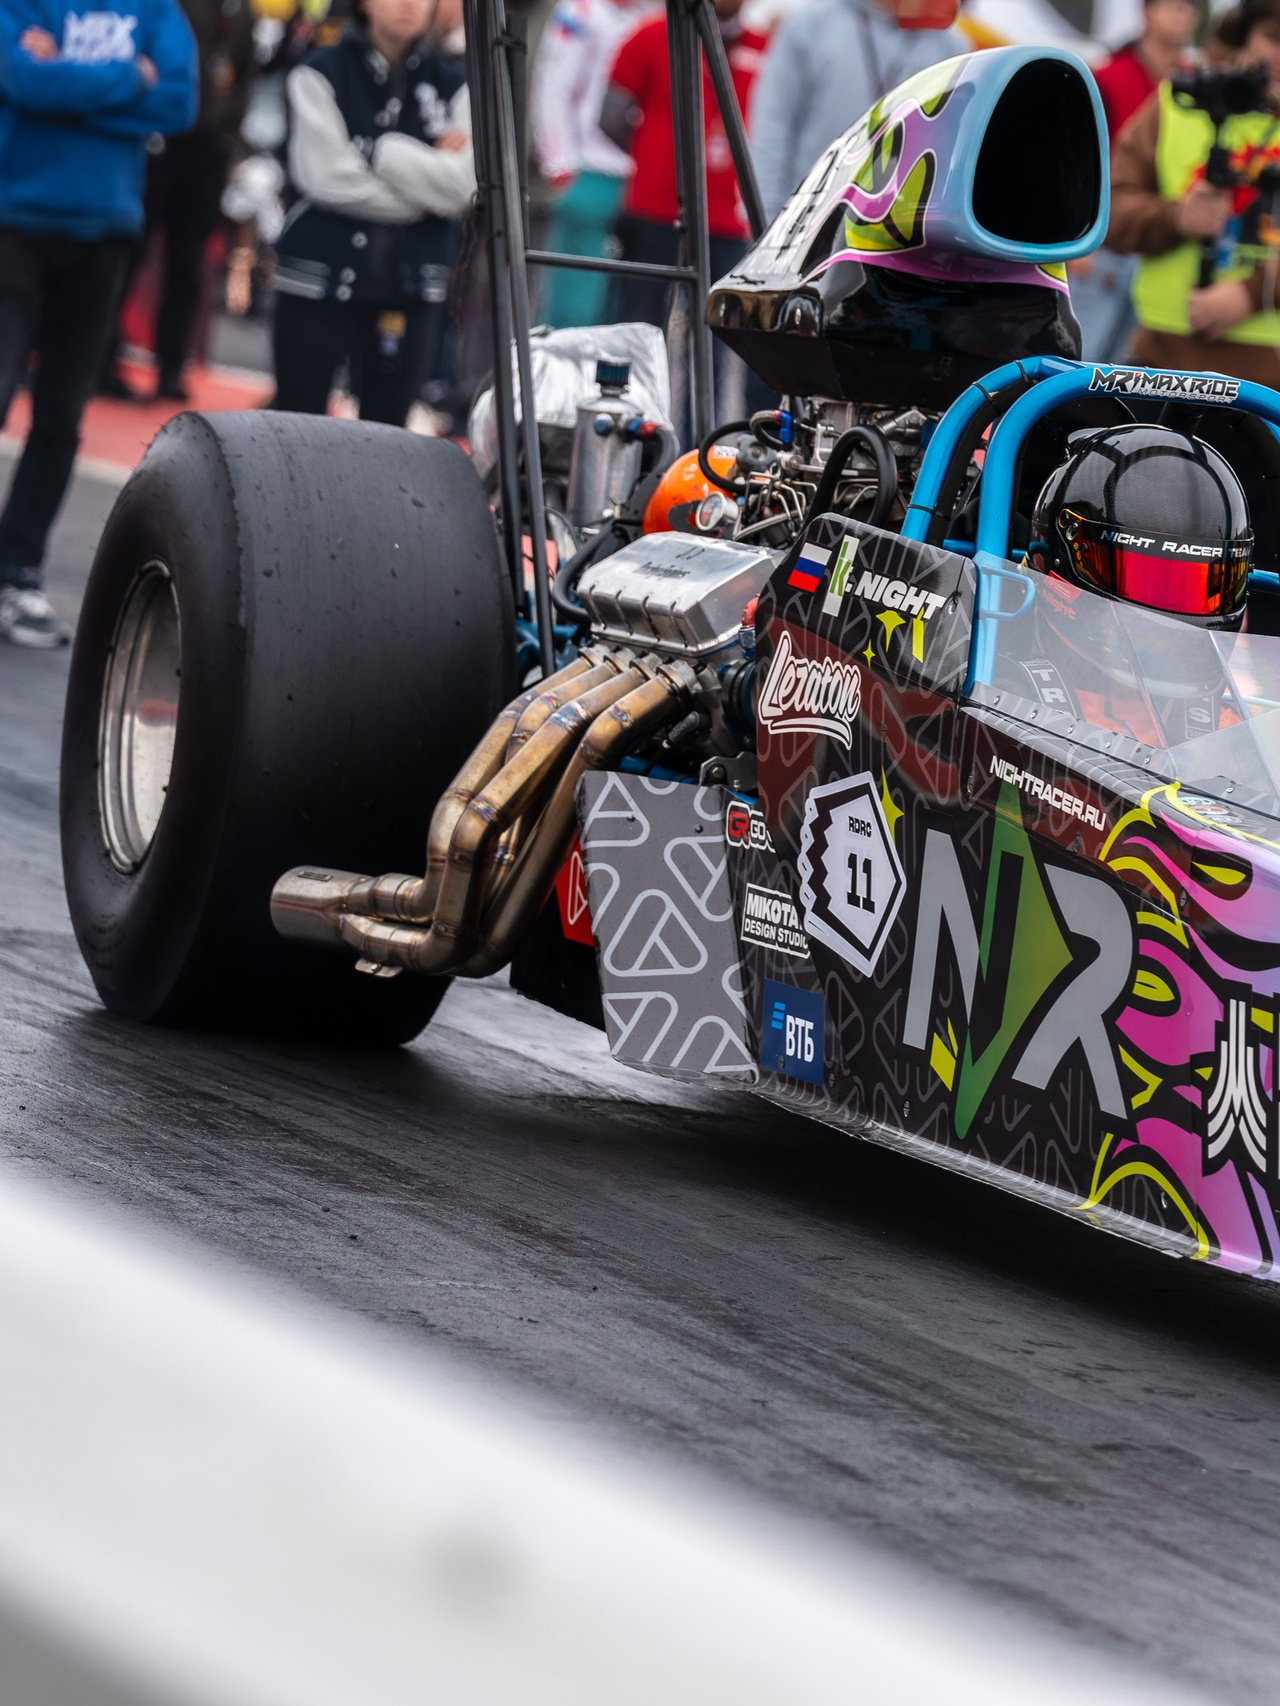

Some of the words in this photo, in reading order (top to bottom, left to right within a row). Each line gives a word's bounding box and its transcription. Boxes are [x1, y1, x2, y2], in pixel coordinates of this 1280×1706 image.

[1138, 389, 1237, 404] MOTORSPORT
[1100, 529, 1155, 549] NIGHT
[1162, 541, 1223, 558] RACER
[854, 570, 947, 620] NIGHT
[989, 755, 1107, 832] NIGHTRACER.RU
[848, 816, 872, 838] RDRC
[847, 853, 875, 914] 11
[744, 917, 777, 941] DESIGN
[746, 893, 804, 931] MIKOTA
[786, 1014, 815, 1063] ВТБ
